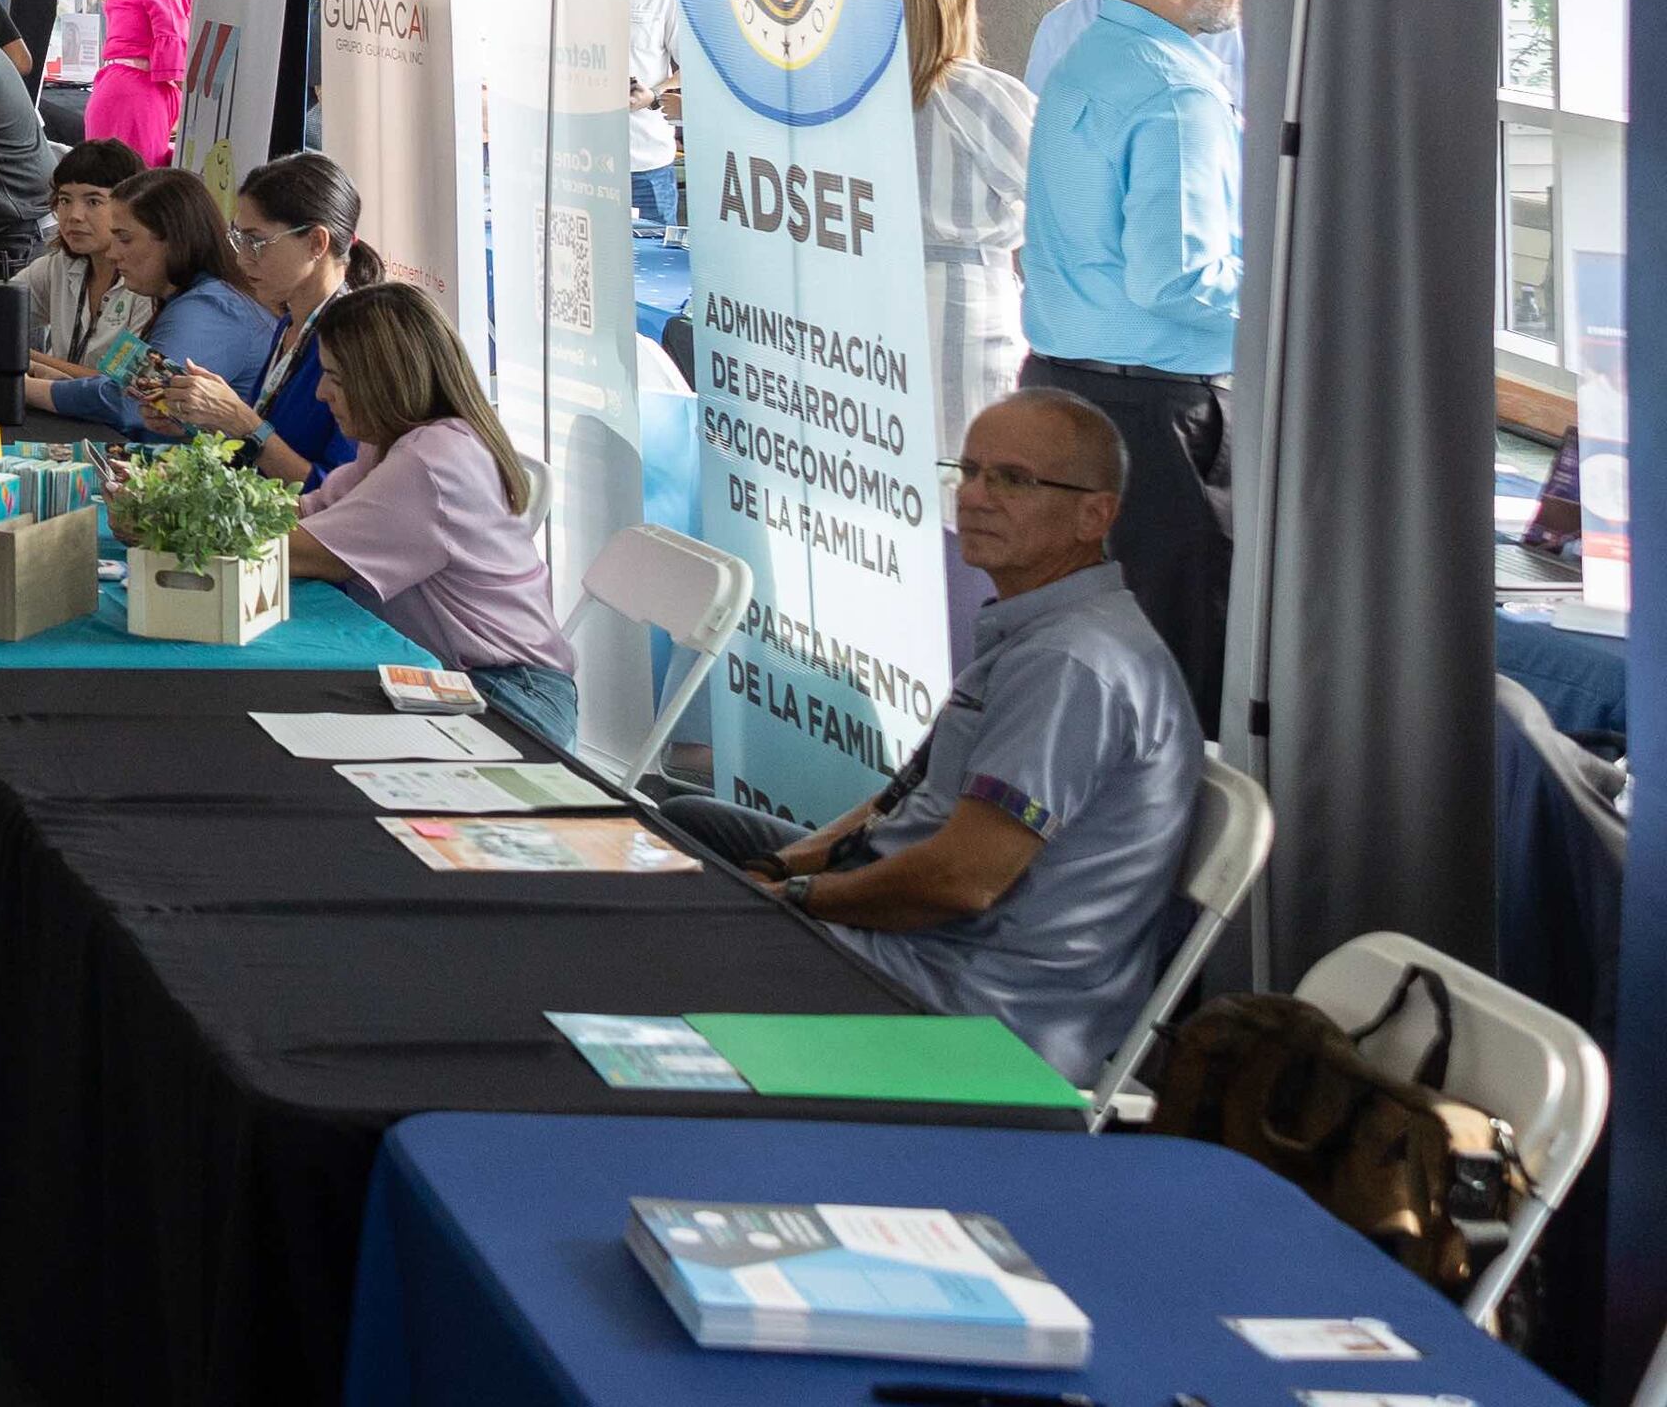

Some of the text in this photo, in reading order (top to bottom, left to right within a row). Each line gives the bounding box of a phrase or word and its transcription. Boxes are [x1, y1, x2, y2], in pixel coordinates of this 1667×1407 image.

[718, 150, 876, 257] ADSEF
[705, 291, 908, 395] ADMINISTRACIÓN
[711, 350, 905, 457] DE DESARROLLO
[703, 405, 924, 529] SOCIOECONÓMICO
[729, 473, 903, 584] DE LA FAMILIA
[728, 651, 905, 778] DE LA FAMILI
[737, 598, 933, 727] PARTAMENTO
